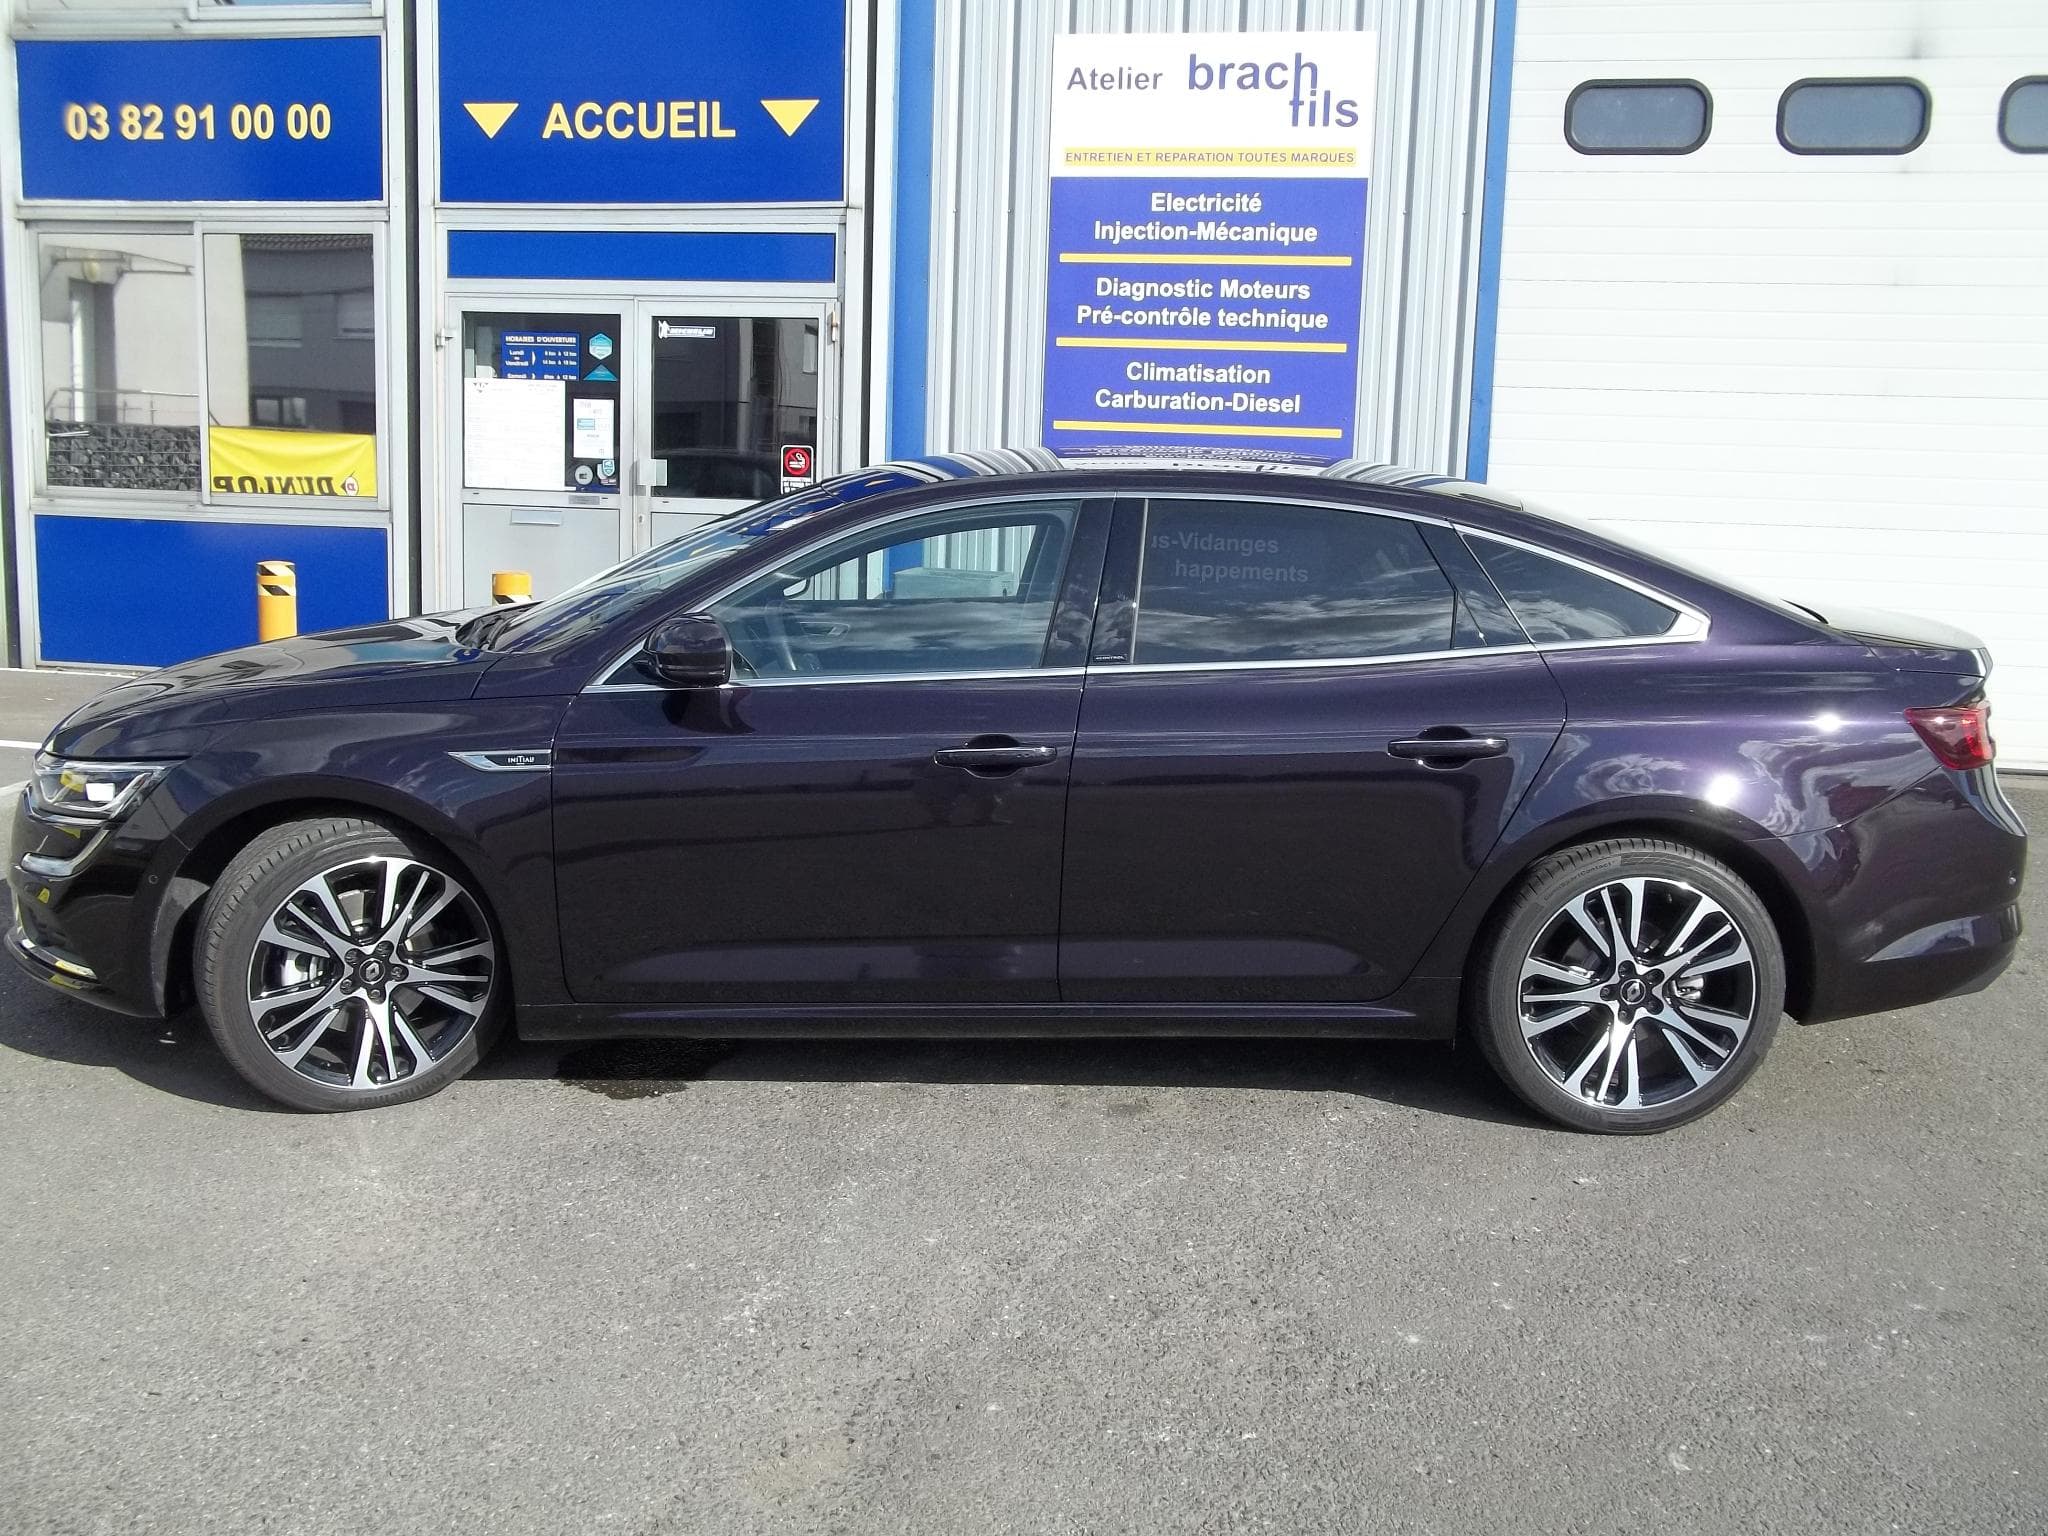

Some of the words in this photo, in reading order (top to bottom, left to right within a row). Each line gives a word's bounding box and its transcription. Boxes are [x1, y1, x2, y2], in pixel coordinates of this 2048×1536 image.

[1066, 67, 1163, 91] Atelier
[1188, 52, 1318, 90] brach
[66, 104, 110, 140] 03
[120, 104, 164, 140] 82
[175, 104, 215, 140] 91
[231, 104, 274, 140] 00
[287, 103, 331, 140] 00
[542, 101, 736, 139] ACCUEIL
[1289, 90, 1359, 127] fils
[1065, 152, 1133, 162] ENTRETIEN
[1137, 152, 1151, 162] ET
[1155, 152, 1234, 162] REPARATION
[1238, 152, 1287, 162] TOUTES
[1291, 152, 1355, 163] MARQUES
[1151, 192, 1262, 213] Electricité
[1094, 220, 1318, 246] Injection-Mécanique
[1096, 277, 1213, 301] Diagnostic
[1220, 278, 1311, 300] Moteurs
[1077, 305, 1210, 327] Pré-contrôle
[1217, 308, 1328, 332] technique
[1126, 362, 1271, 384] Climatisation
[1095, 389, 1301, 414] Carburation-Diesel
